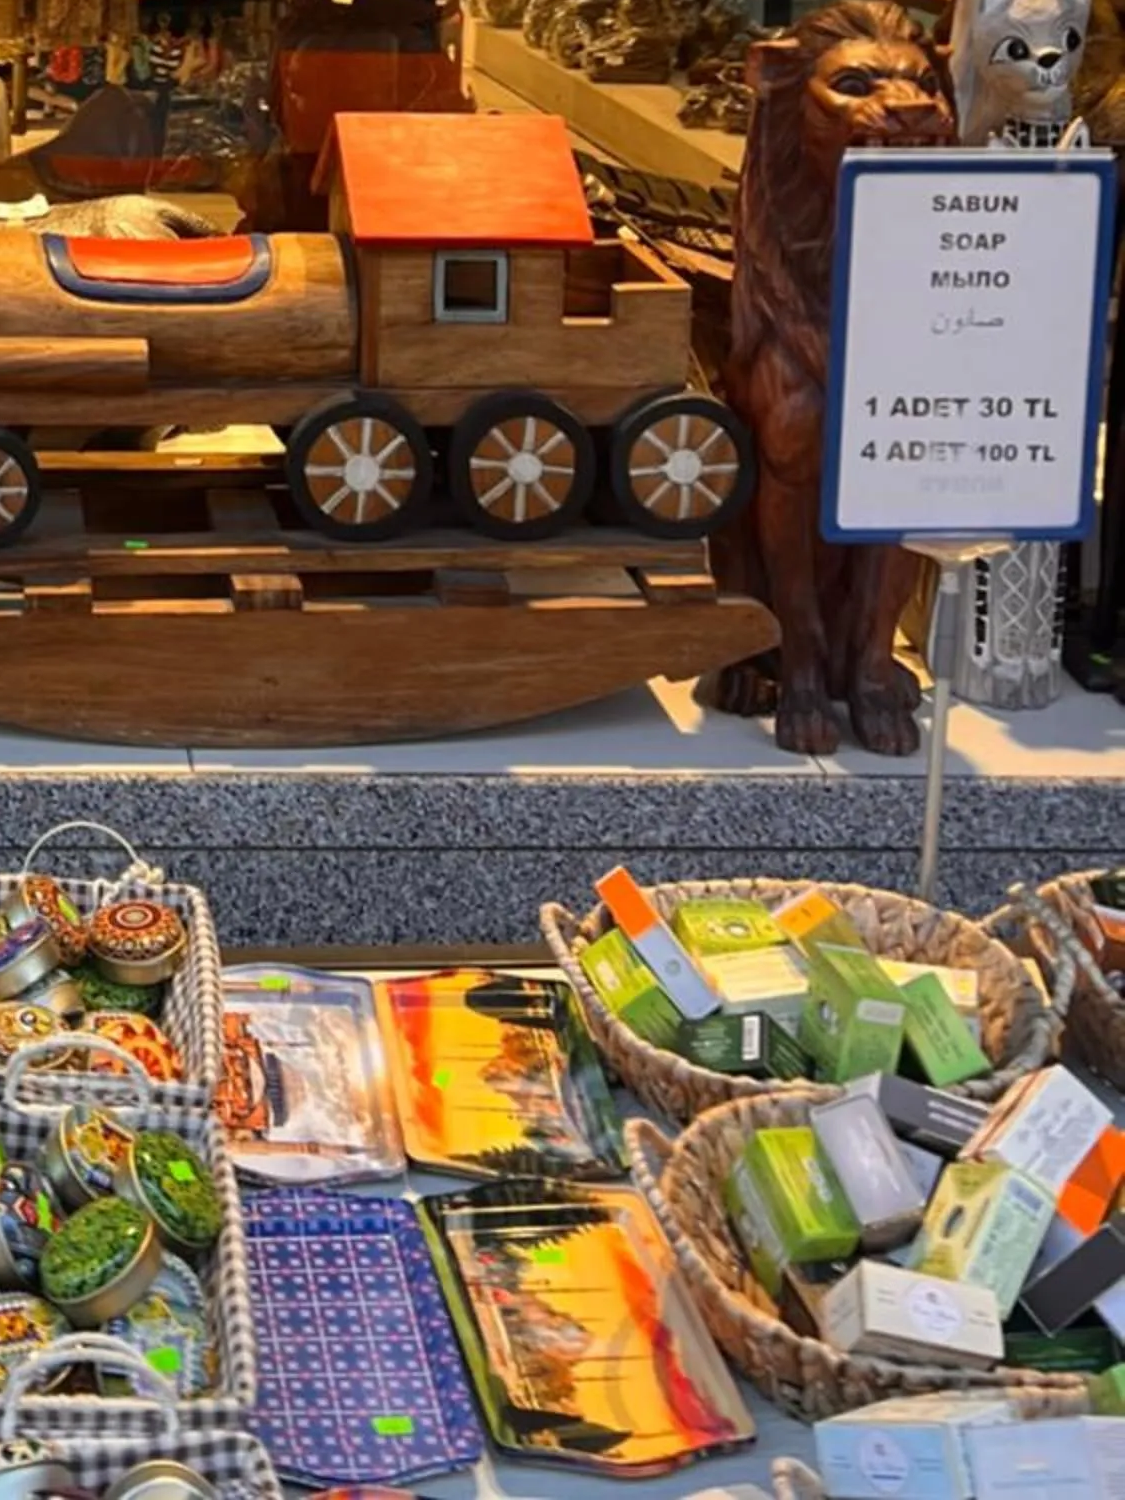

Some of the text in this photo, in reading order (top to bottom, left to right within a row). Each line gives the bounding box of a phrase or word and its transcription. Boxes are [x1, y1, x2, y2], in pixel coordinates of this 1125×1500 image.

[932, 195, 1019, 212] SABUN
[939, 232, 1007, 250] SOAP
[930, 271, 1010, 288] МЫЛО
[865, 396, 1059, 418] 1 ADET 30 TL
[860, 440, 1056, 462] 4 ADET 100 TL
